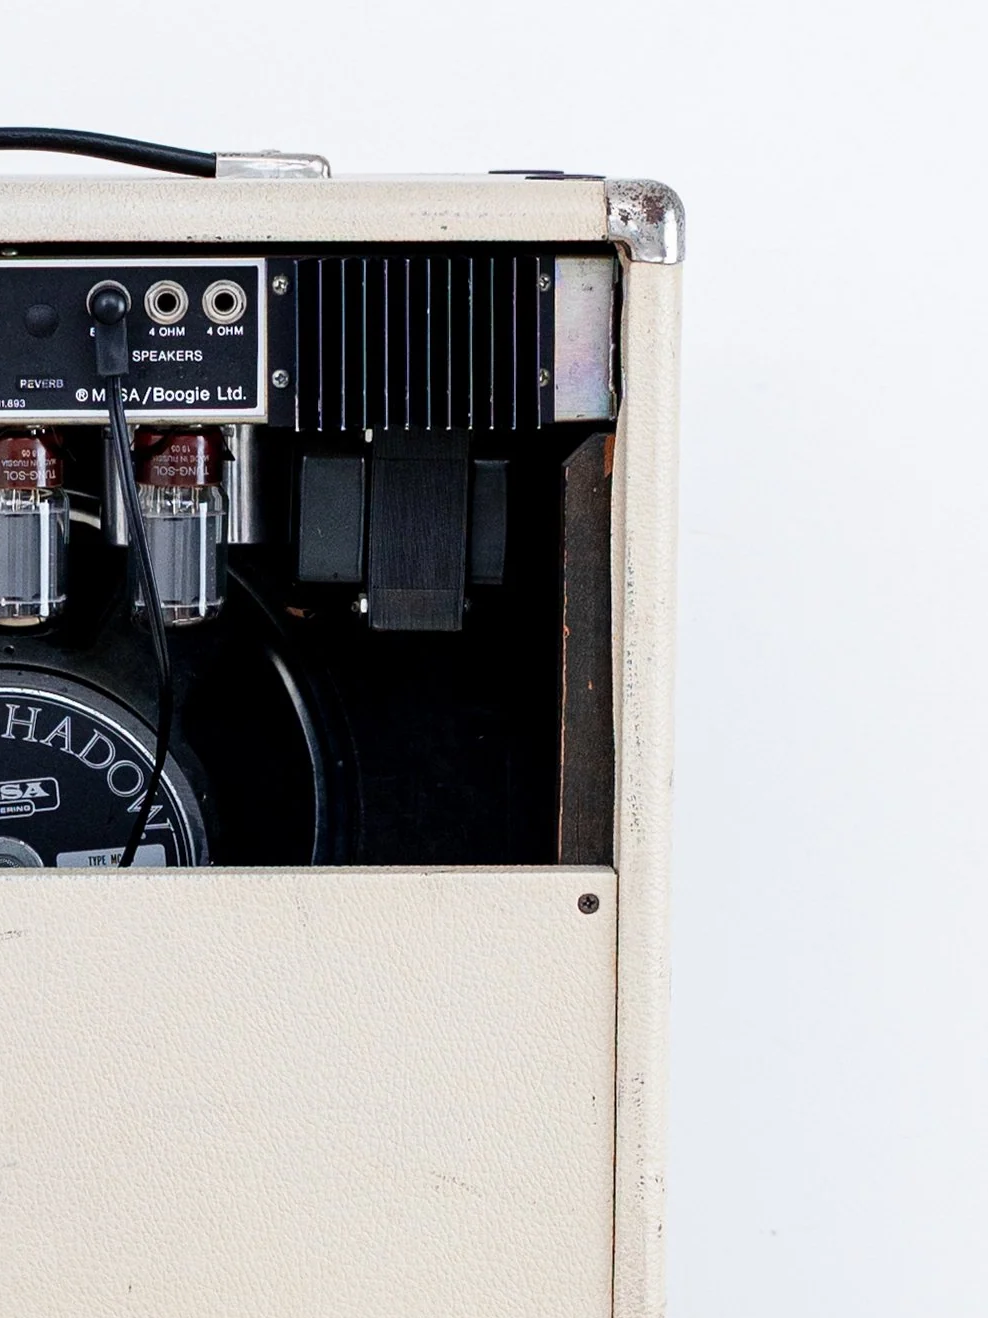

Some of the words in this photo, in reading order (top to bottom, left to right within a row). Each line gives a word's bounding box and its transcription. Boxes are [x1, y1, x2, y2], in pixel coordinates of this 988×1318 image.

[148, 327, 155, 336] 4
[159, 327, 186, 336] OHM
[206, 326, 213, 335] 4
[217, 326, 244, 336] OHM
[132, 350, 203, 362] SPEAKERS
[92, 386, 210, 405] MSA/Boogie
[217, 386, 247, 401] Ltd.
[3, 470, 57, 481] TUG-SOL
[153, 466, 209, 477] TNG-SOL
[88, 854, 107, 866] TYPE
